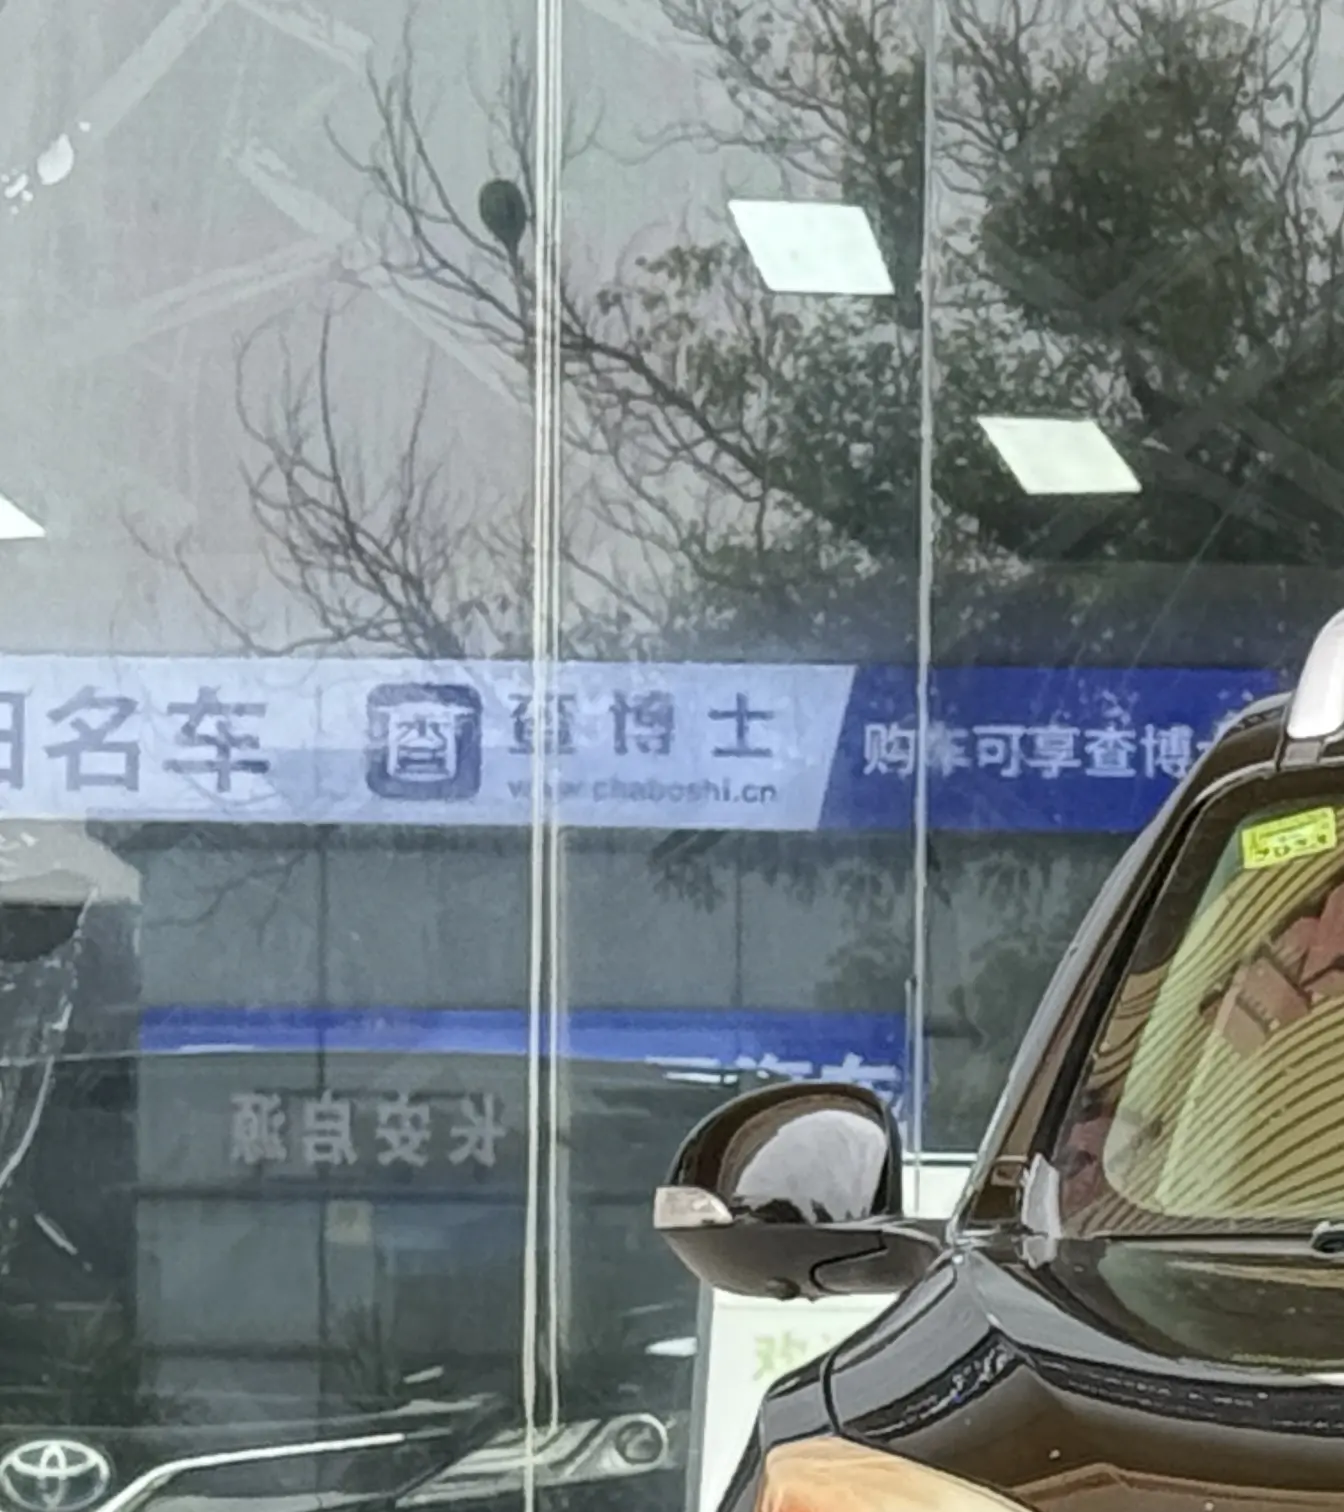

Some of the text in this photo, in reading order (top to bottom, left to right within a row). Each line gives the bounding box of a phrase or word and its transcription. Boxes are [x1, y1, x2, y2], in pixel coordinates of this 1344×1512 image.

[0, 684, 270, 793] 名车
[862, 722, 1213, 778] 购车可享查博
